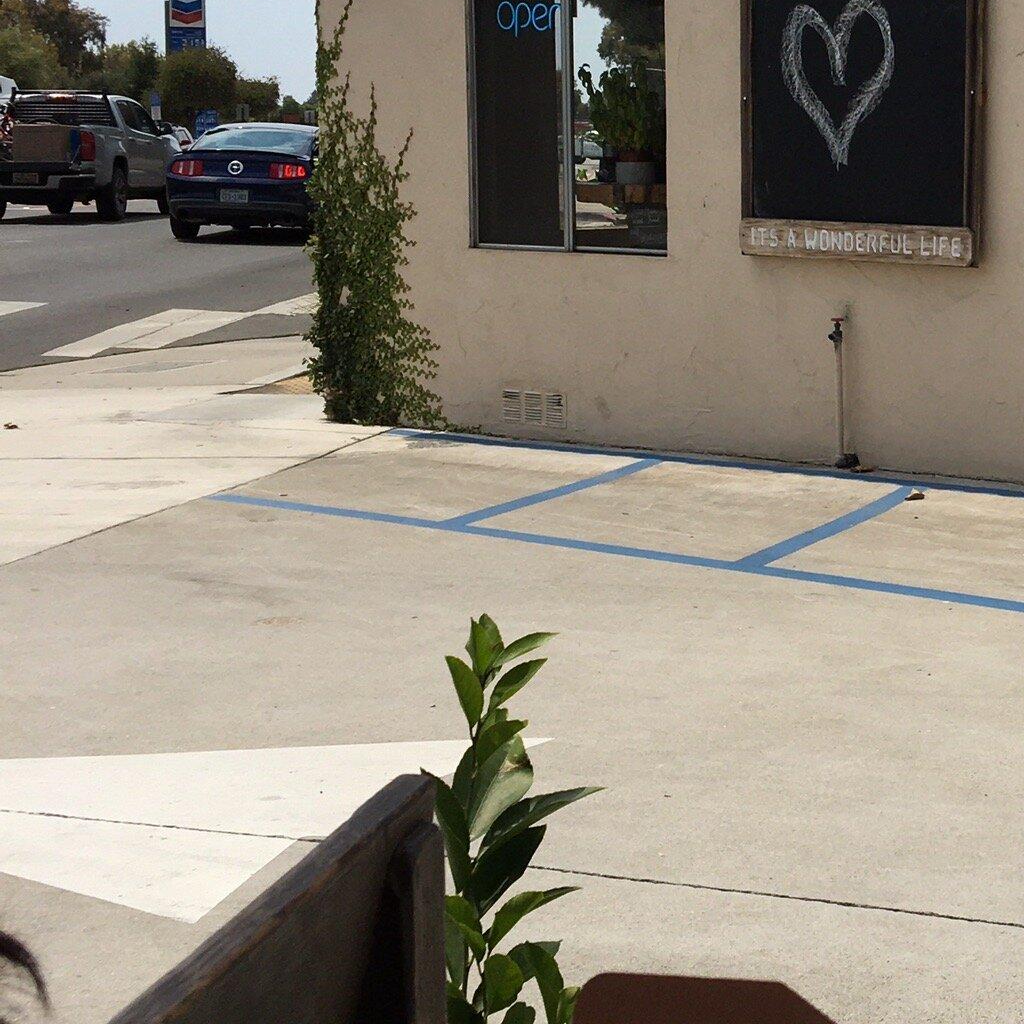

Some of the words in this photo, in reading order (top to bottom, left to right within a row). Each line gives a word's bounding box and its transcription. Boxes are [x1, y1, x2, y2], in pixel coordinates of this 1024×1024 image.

[787, 228, 796, 248] A
[804, 229, 912, 255] WONDERFUL
[920, 235, 962, 258] LIFE
